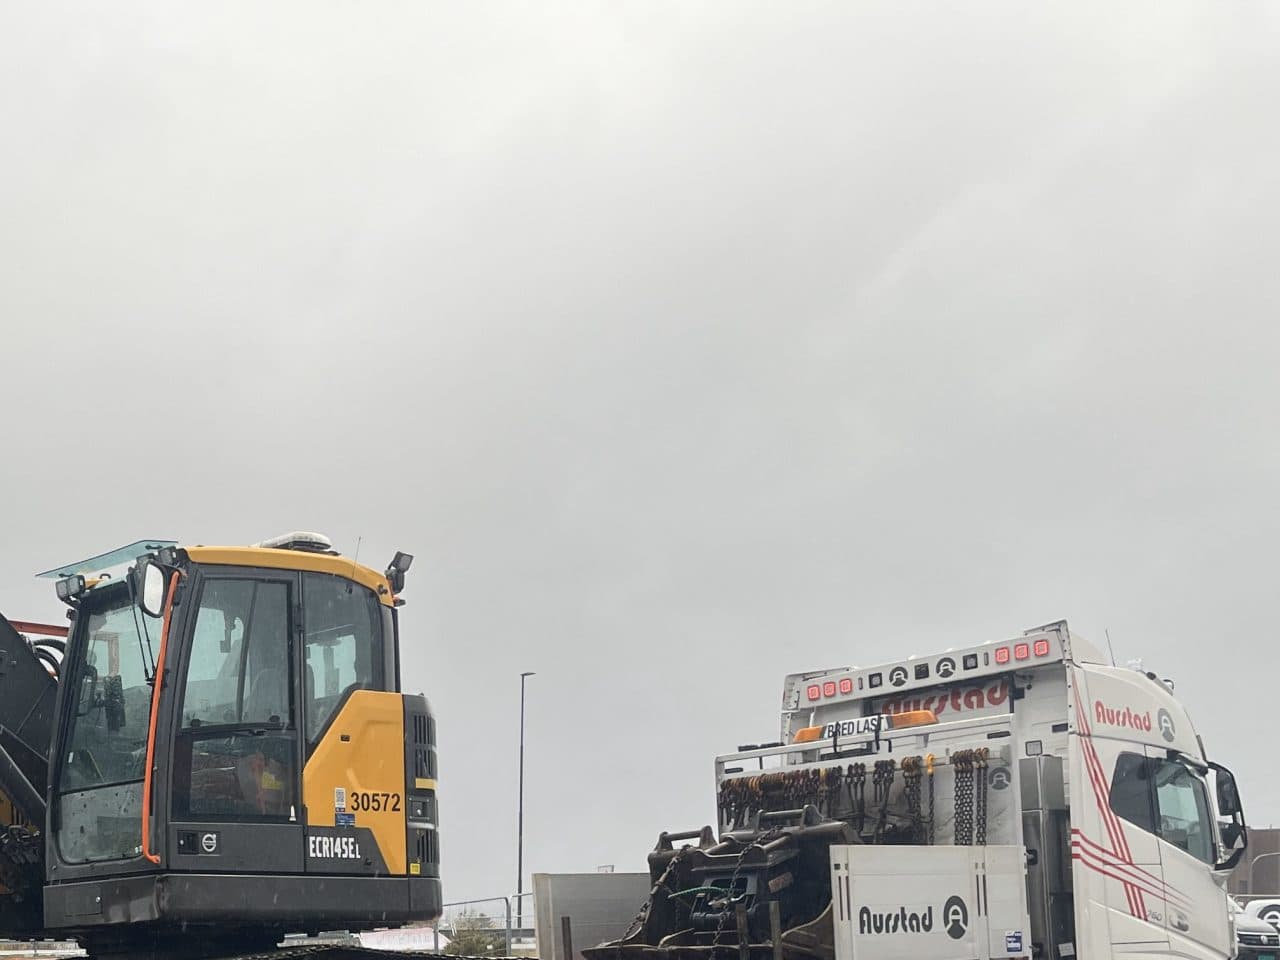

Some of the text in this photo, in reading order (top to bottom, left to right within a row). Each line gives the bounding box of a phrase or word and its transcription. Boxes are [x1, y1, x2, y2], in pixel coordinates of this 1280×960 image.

[1095, 700, 1152, 732] Aurstad
[827, 721, 855, 738] BRED
[350, 791, 401, 812] 30572
[859, 906, 933, 934] Aurstad
